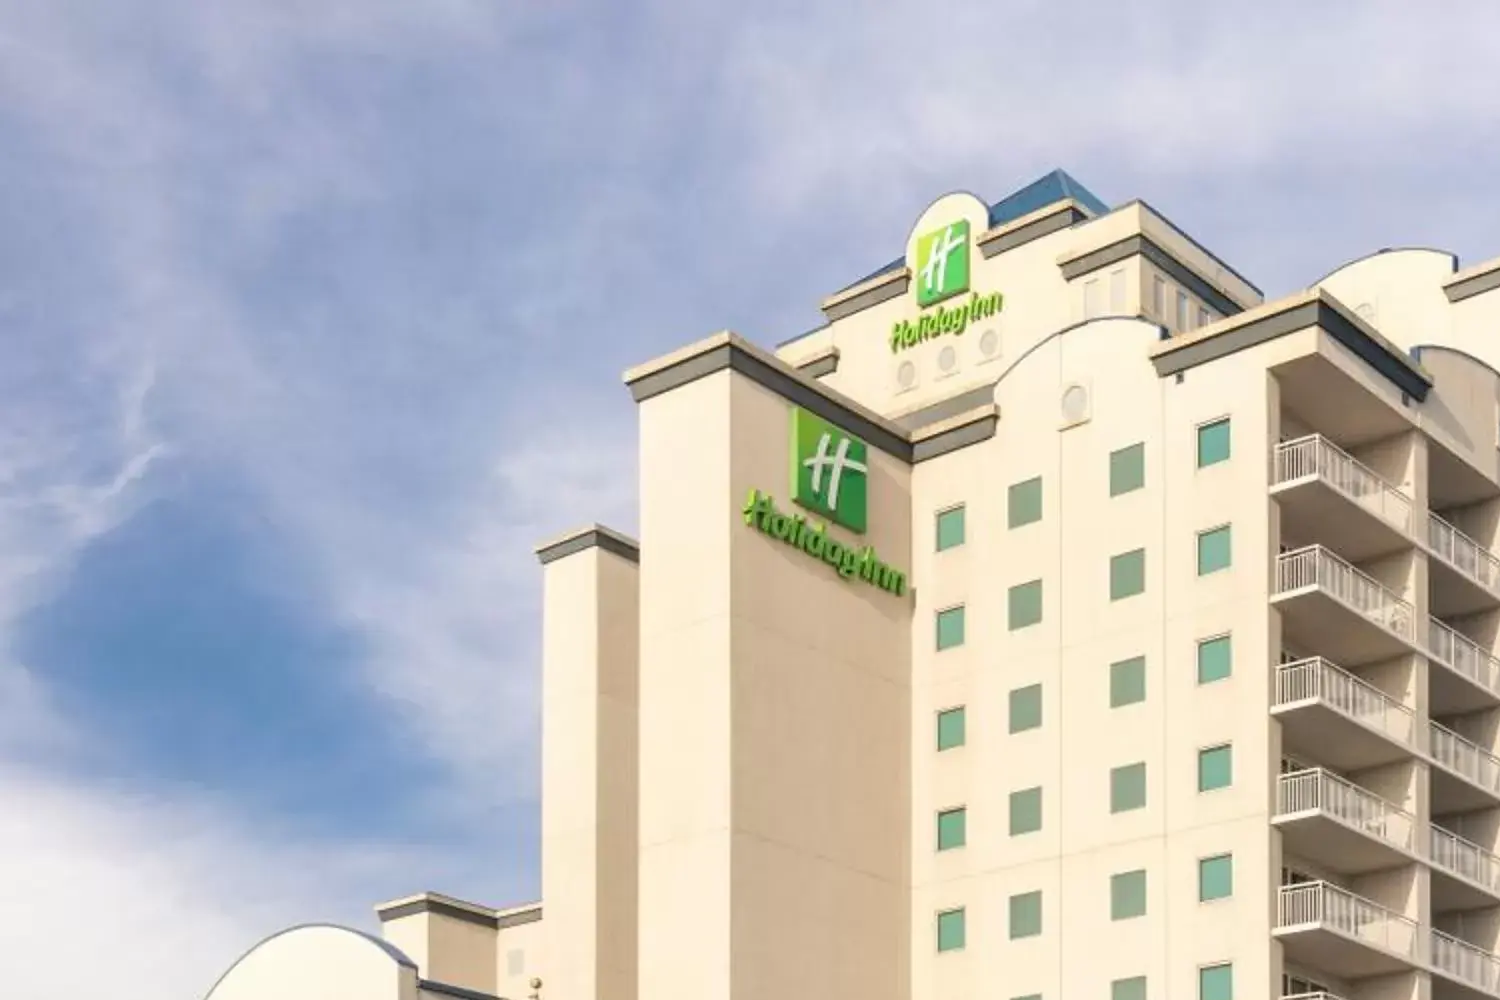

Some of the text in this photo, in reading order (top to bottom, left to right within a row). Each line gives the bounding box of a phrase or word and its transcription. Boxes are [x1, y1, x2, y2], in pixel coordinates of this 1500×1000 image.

[891, 292, 1003, 354] Holiday Inn
[742, 489, 907, 597] Holiday Inn
